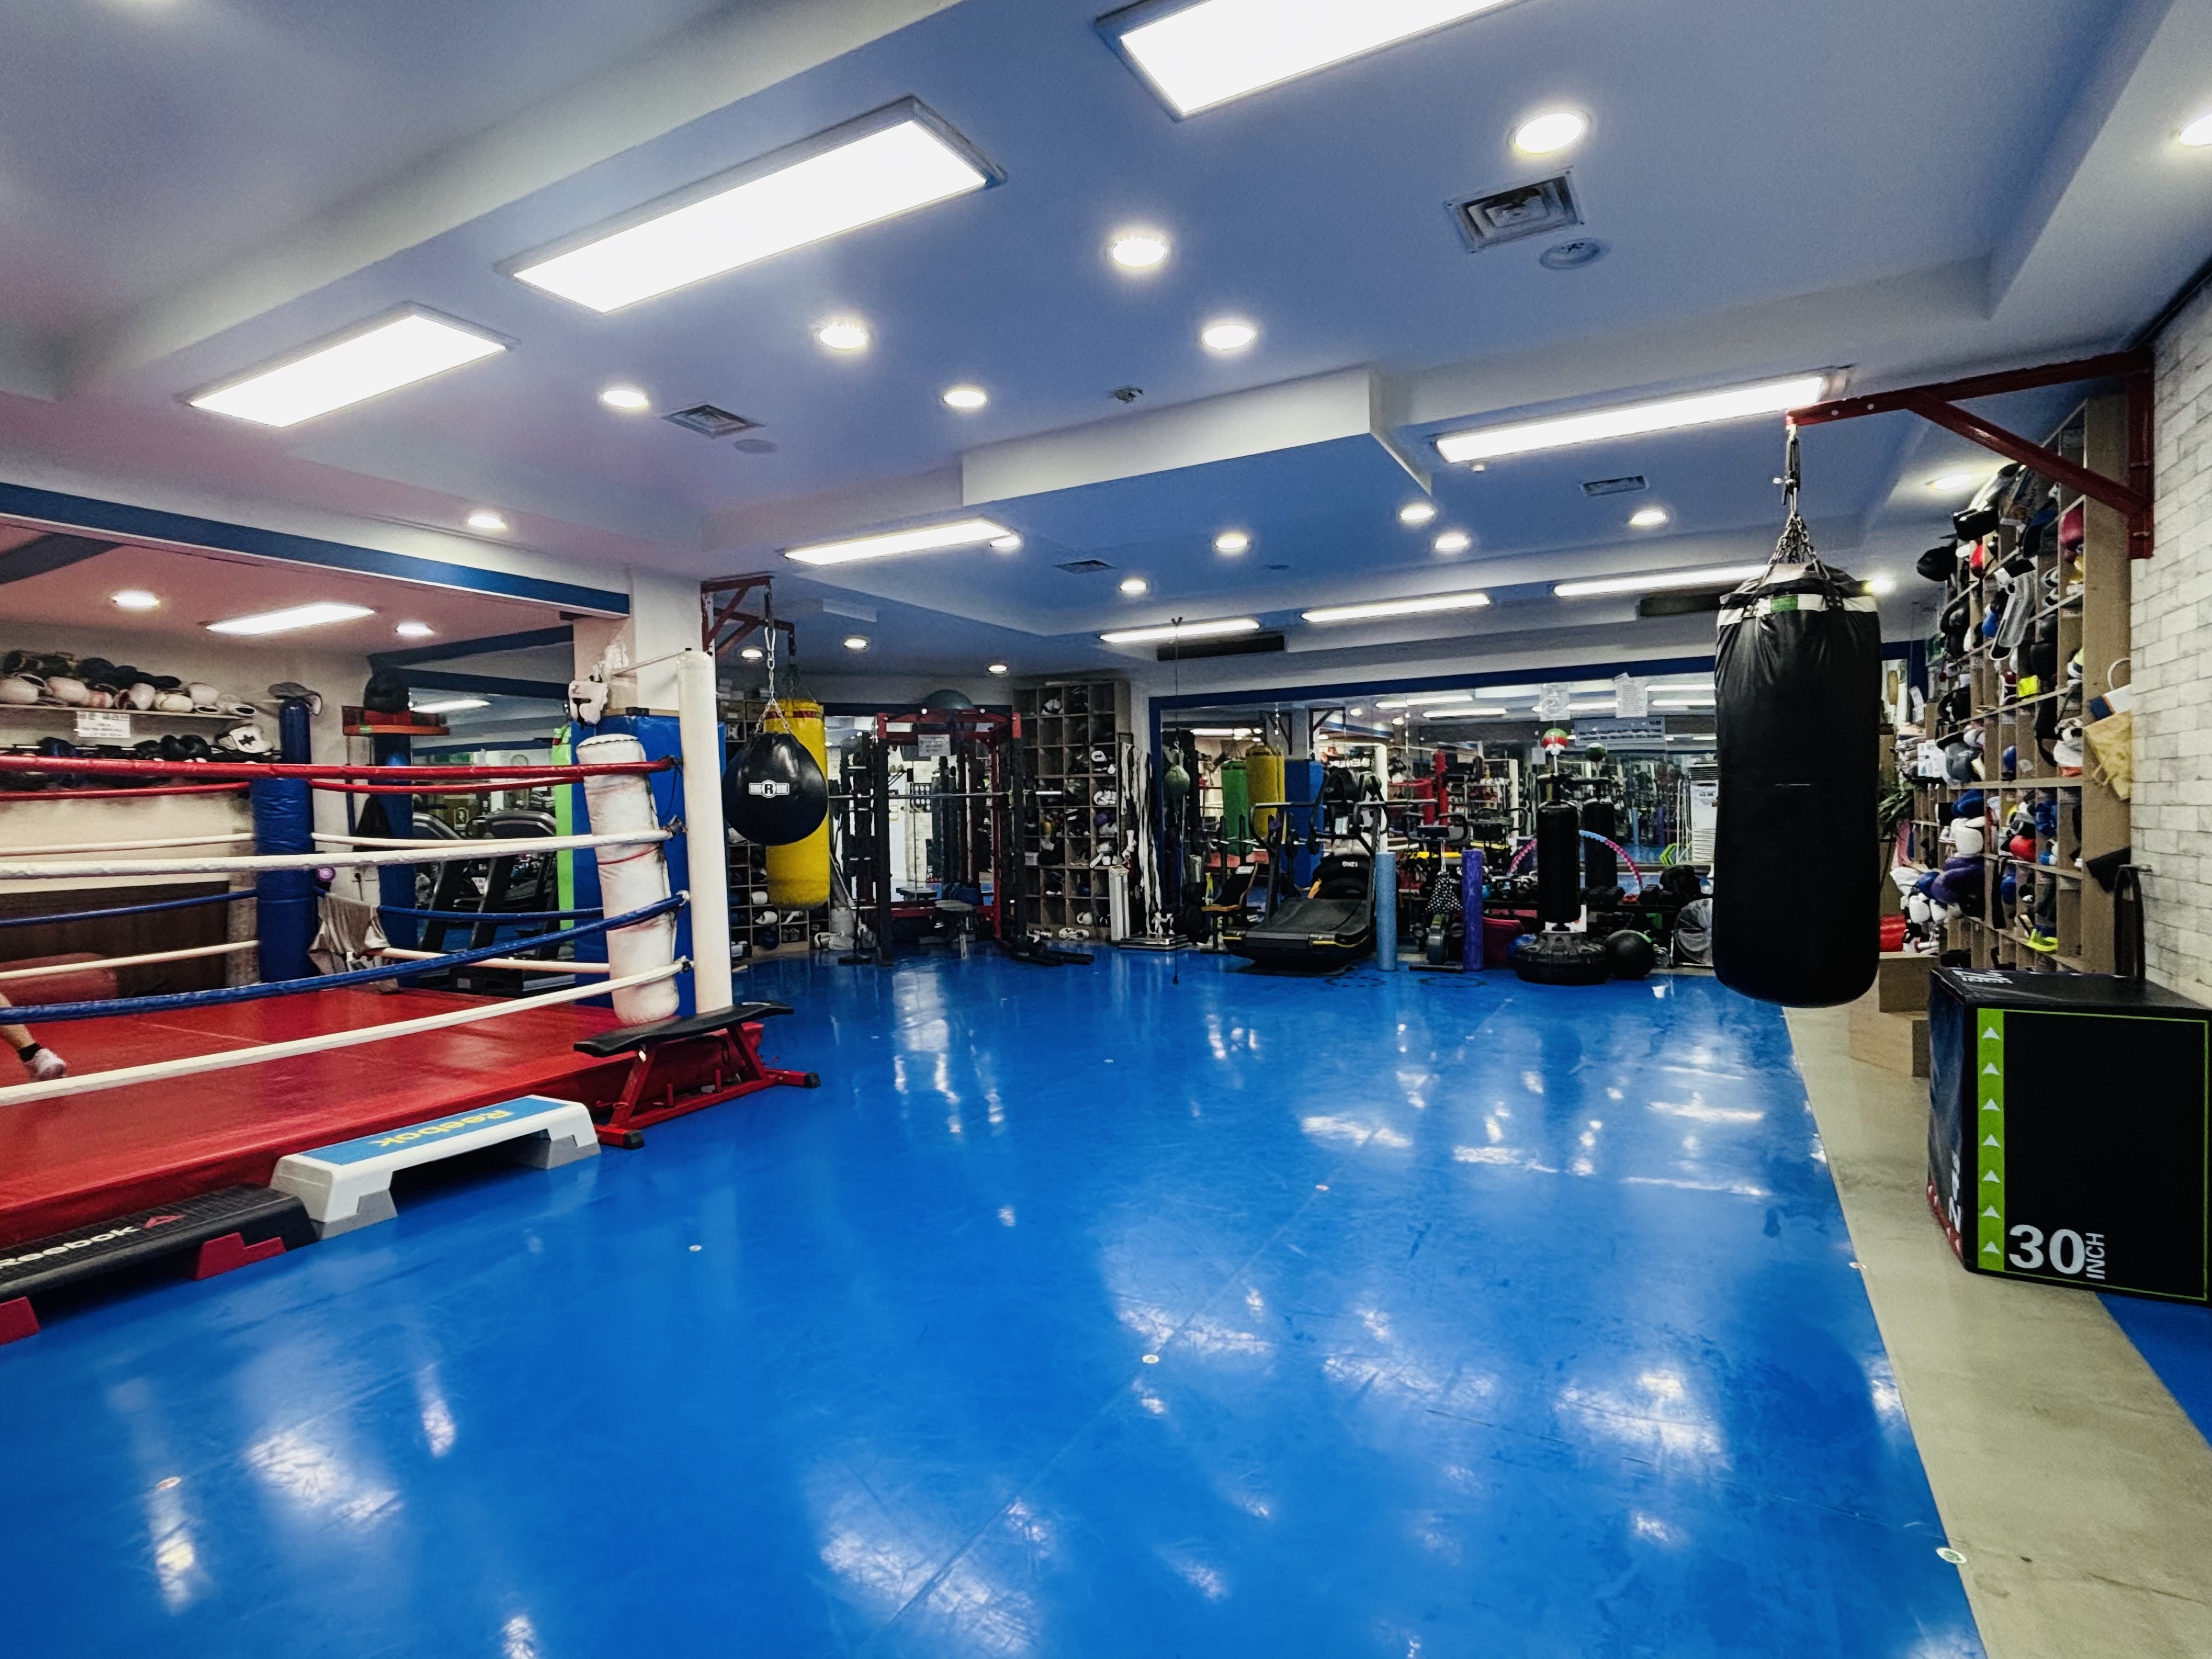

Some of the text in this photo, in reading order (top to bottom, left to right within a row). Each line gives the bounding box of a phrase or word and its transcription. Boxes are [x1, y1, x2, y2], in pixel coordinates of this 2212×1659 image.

[765, 783, 774, 794] R
[369, 1110, 514, 1147] Reebok
[2008, 1224, 2106, 1279] 30 INCH
